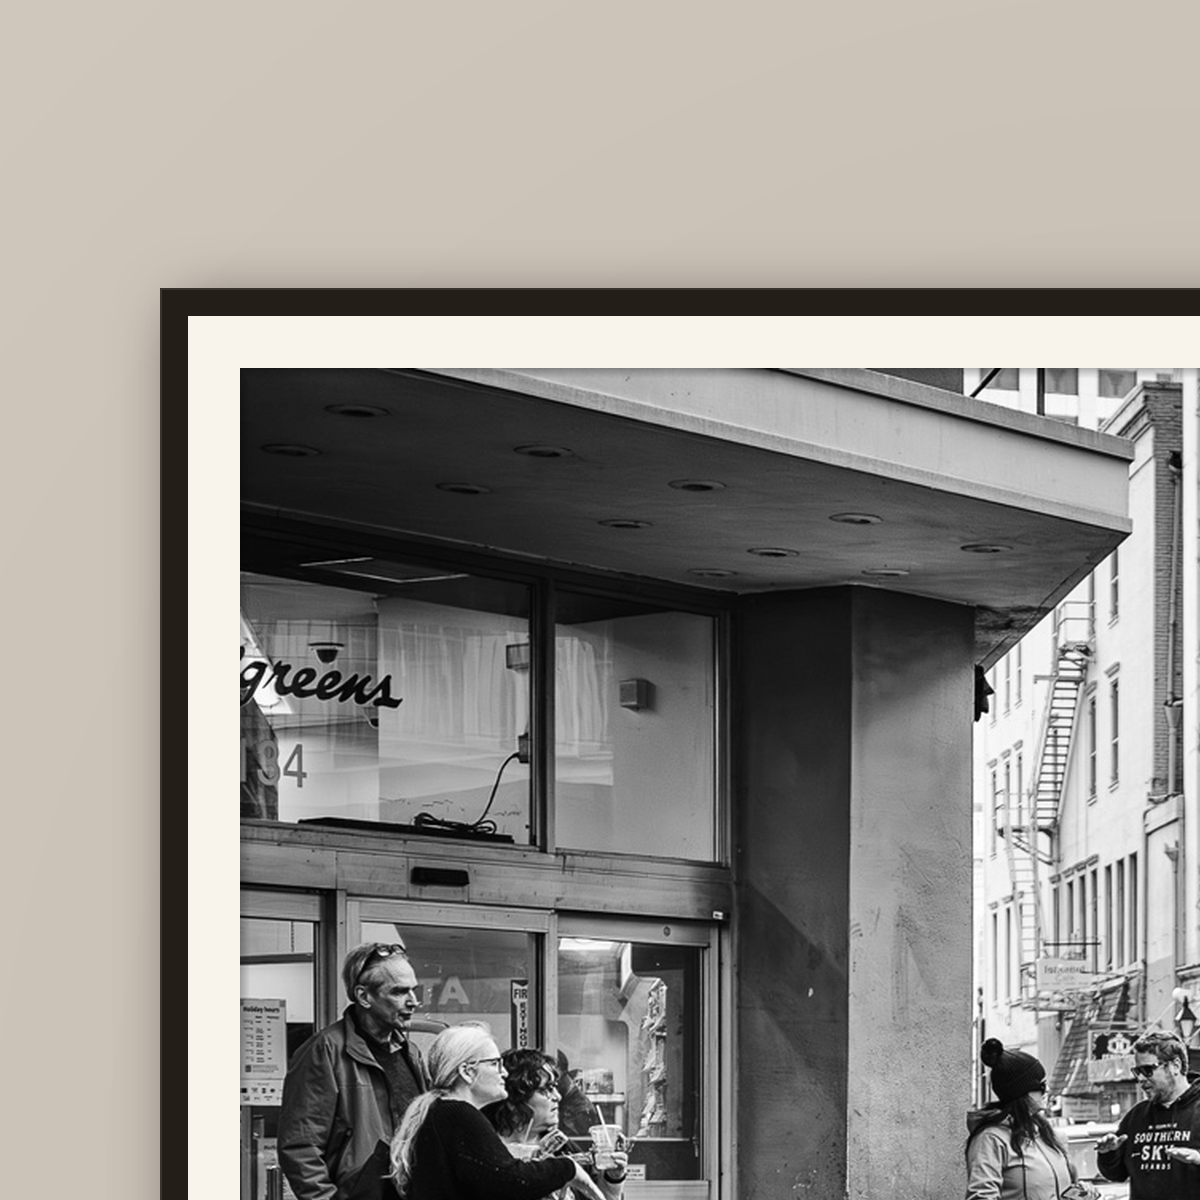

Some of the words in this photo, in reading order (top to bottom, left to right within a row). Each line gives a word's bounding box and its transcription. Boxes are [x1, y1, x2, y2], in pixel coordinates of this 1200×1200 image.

[239, 646, 403, 709] greens
[243, 1006, 263, 1014] Holiday
[1134, 1130, 1191, 1144] SOUTHERN
